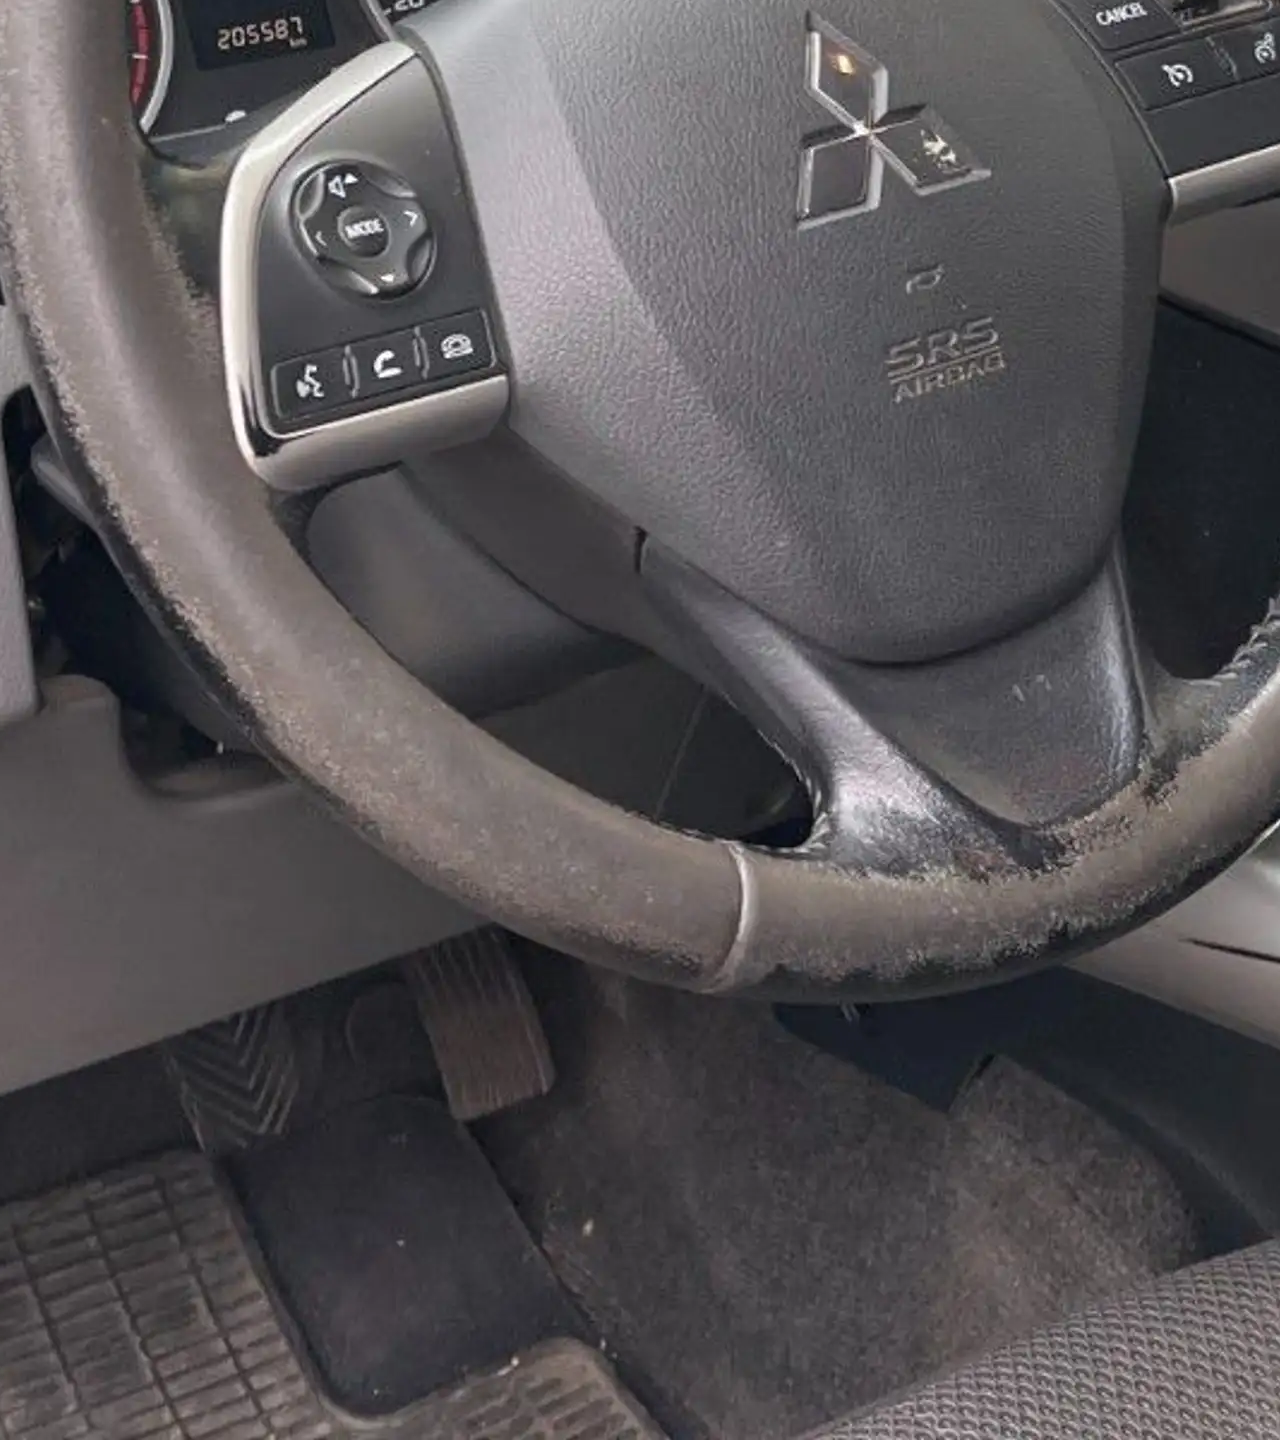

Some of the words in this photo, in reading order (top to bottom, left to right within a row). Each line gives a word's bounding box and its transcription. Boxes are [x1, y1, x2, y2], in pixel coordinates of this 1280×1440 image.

[1095, 1, 1148, 26] CANCEL
[217, 16, 303, 50] 205587
[345, 218, 384, 238] MODE
[884, 316, 1000, 378] SRS
[893, 351, 1006, 404] AIRBAG
